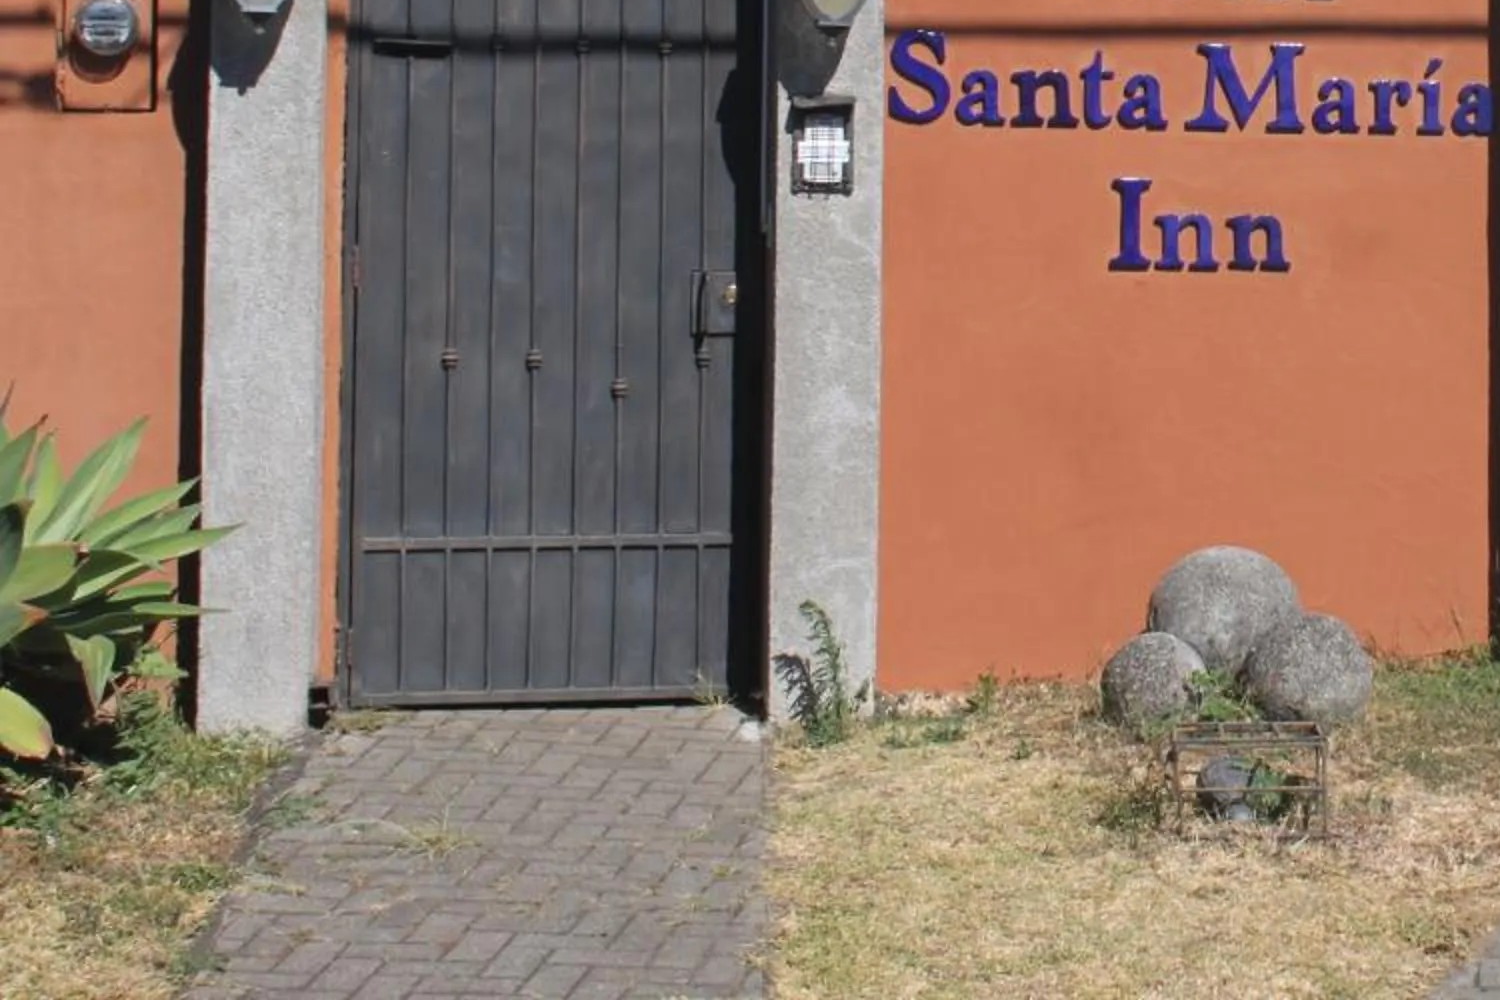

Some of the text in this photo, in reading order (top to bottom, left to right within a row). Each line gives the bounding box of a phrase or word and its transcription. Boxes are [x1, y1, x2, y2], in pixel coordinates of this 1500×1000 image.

[887, 28, 1494, 137] Santa María
[1108, 177, 1291, 273] Inn
